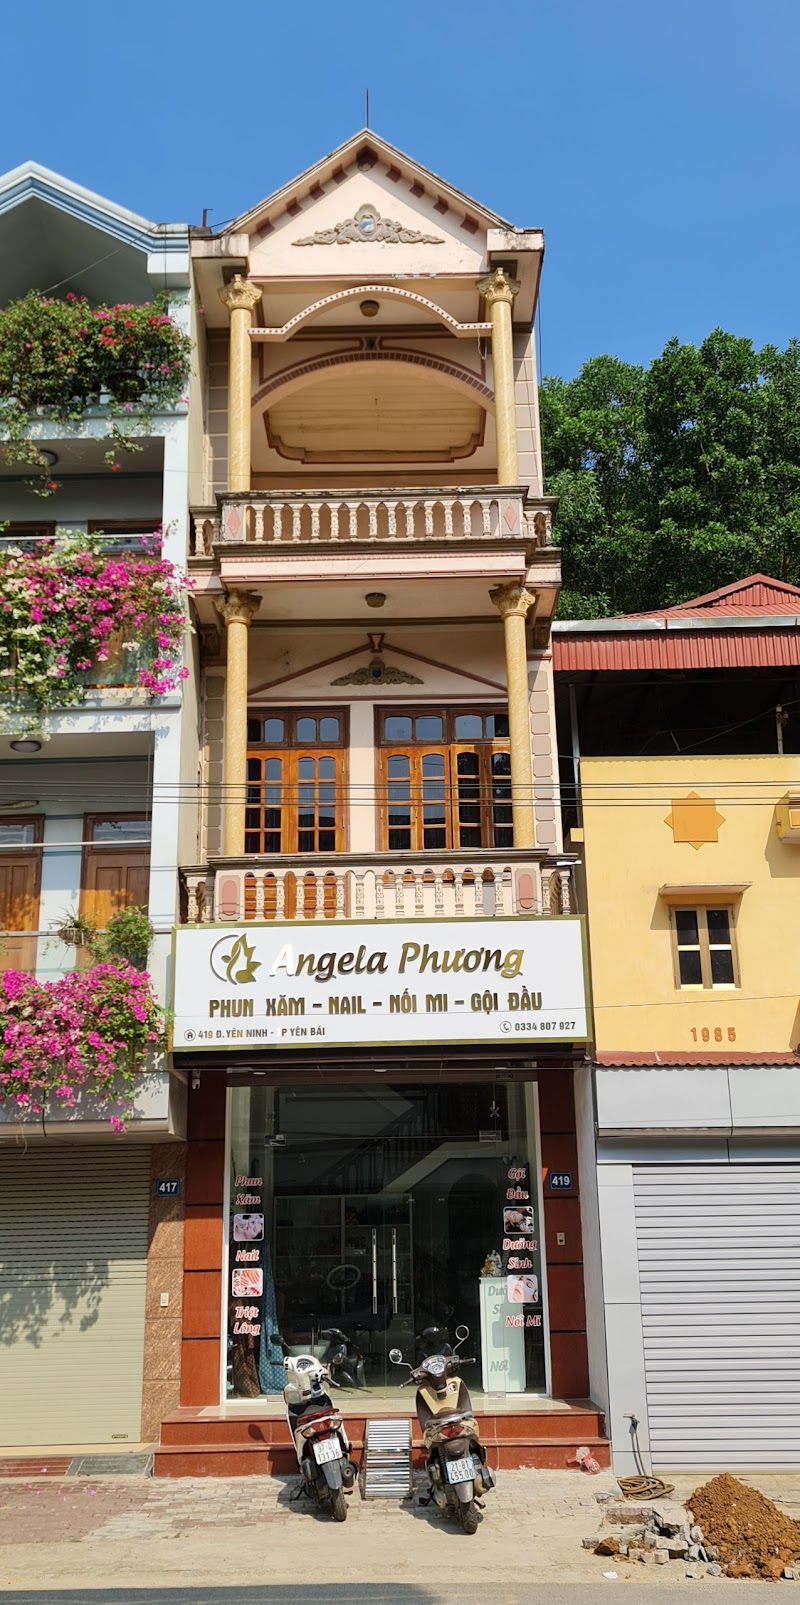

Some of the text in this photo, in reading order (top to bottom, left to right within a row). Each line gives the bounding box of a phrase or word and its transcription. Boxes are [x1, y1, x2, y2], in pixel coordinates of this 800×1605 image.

[269, 942, 525, 981] Angela Phương
[209, 998, 254, 1018] PHUN
[266, 995, 305, 1016] XĂM
[328, 996, 366, 1015] NAIL
[389, 987, 417, 1013] NỐI
[426, 993, 448, 1012] MI
[470, 989, 499, 1015] GỘI
[508, 984, 543, 1011] ĐẦU
[198, 1030, 214, 1039] 419
[246, 1029, 268, 1038] NINH
[290, 1026, 307, 1037] YÊN
[310, 1025, 326, 1036] BÁI
[514, 1021, 576, 1032] 0334 807 927
[690, 1026, 737, 1043] 1985
[234, 1175, 263, 1187] Phun
[507, 1167, 527, 1181] Gội
[552, 1175, 570, 1186] 419
[159, 1182, 178, 1193] 417
[235, 1193, 262, 1205] Xăm
[502, 1237, 538, 1252] Dưỡng
[235, 1249, 260, 1262] Nail
[507, 1257, 533, 1270] Sinh
[234, 1306, 260, 1320] Triệt
[504, 1313, 542, 1327] Nối Mi
[233, 1322, 261, 1336] Lông
